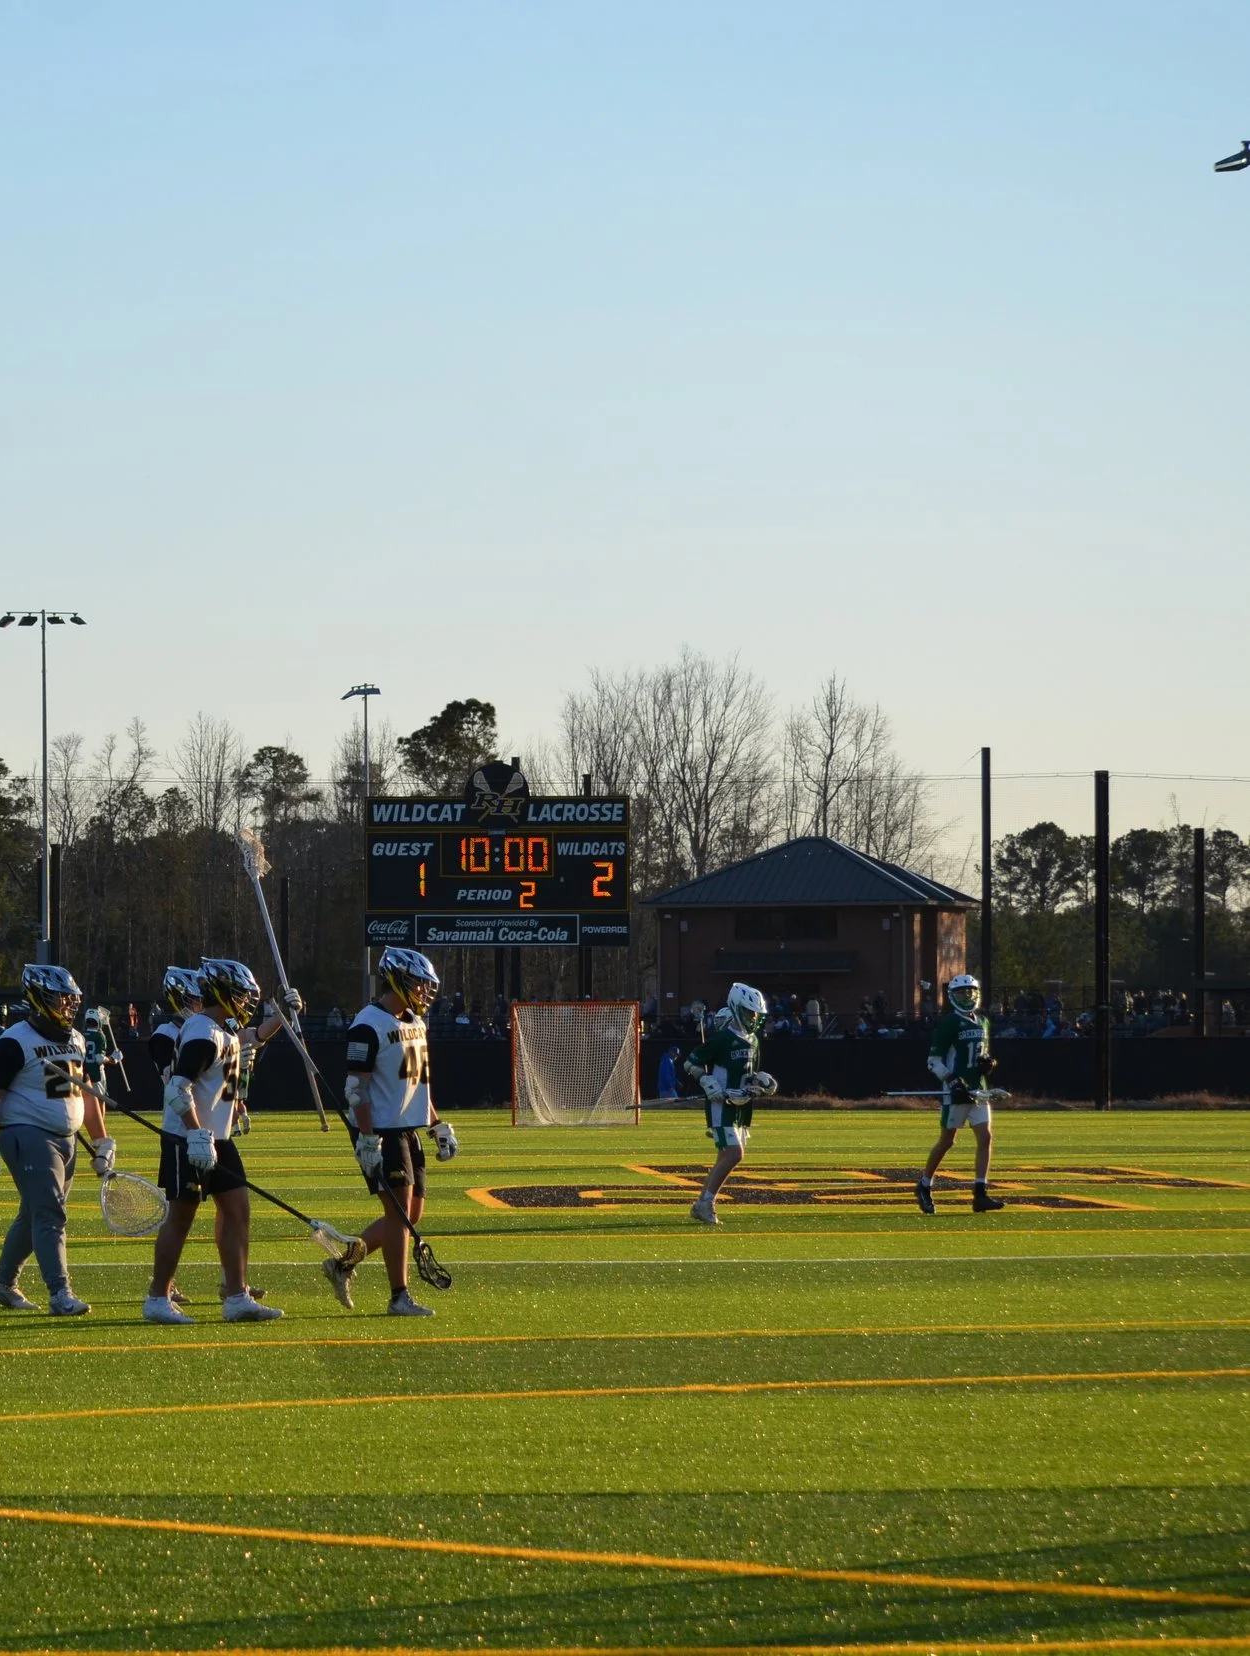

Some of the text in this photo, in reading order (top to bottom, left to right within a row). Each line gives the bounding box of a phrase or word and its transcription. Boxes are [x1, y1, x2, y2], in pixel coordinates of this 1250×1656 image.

[372, 803, 624, 822] WILDCAT LACROSSE
[371, 842, 434, 856] GUEST
[460, 837, 549, 872] 10:00
[556, 841, 626, 856] WILDCATS
[419, 862, 426, 897] 1
[592, 861, 614, 897] 2
[456, 889, 512, 901] PERIOD
[519, 881, 536, 908] 2
[455, 919, 539, 928] Scoreboard Provided By
[426, 927, 569, 941] Savannah Coca-Cola
